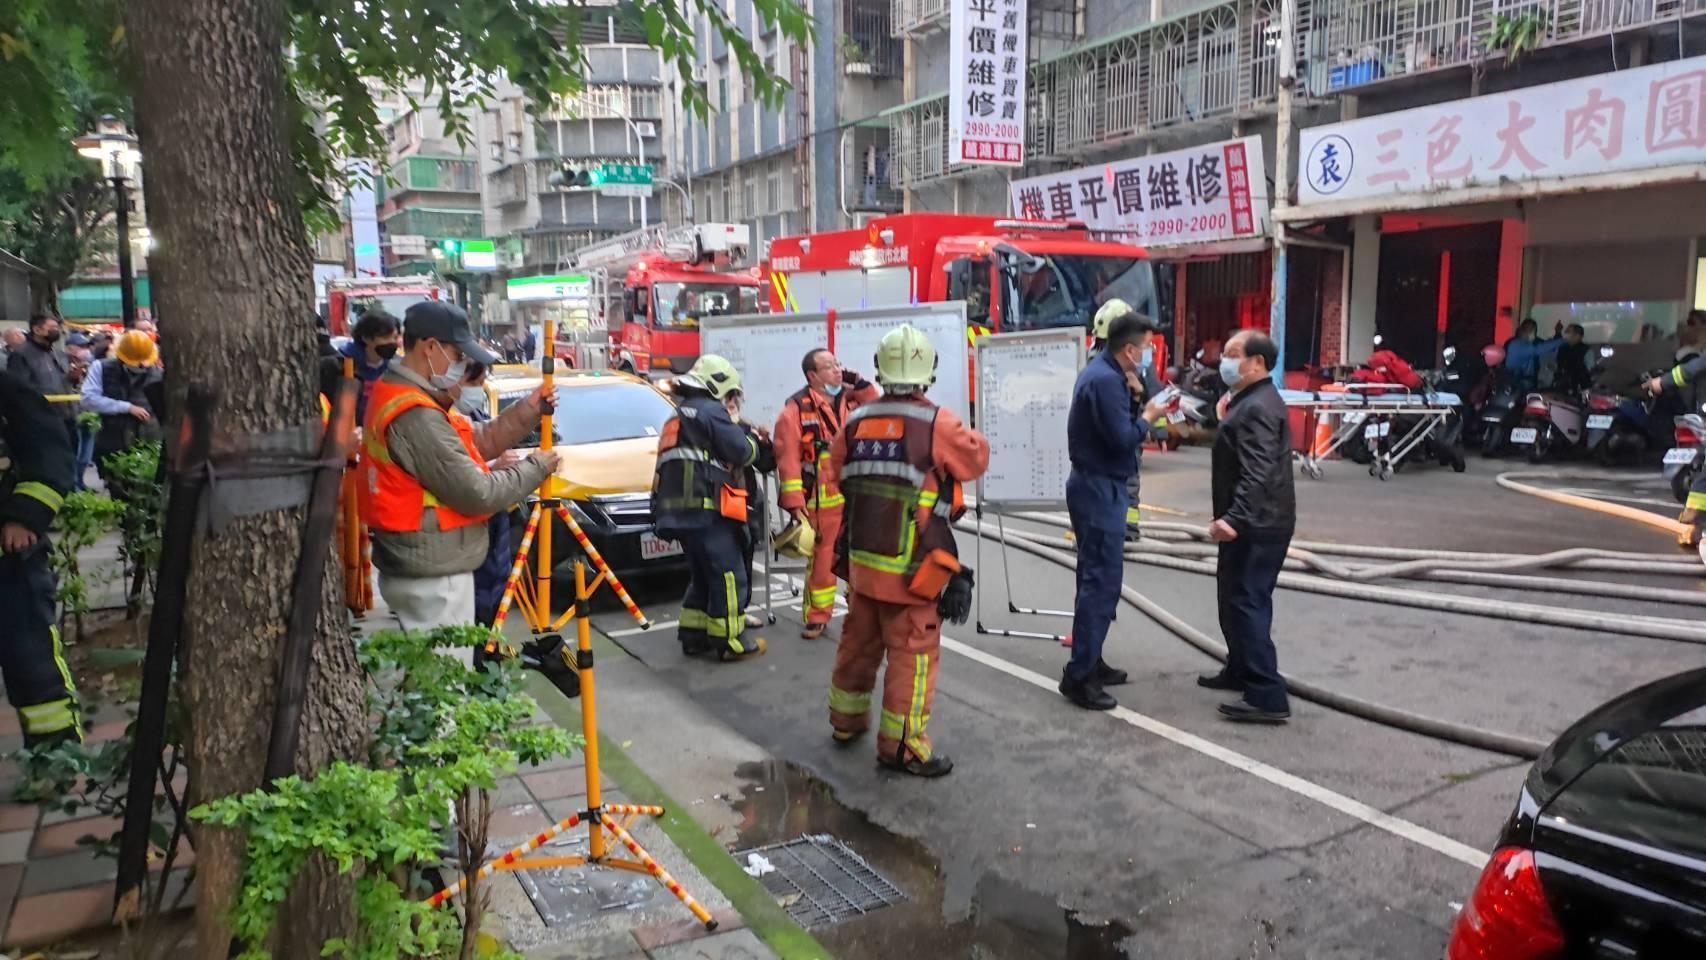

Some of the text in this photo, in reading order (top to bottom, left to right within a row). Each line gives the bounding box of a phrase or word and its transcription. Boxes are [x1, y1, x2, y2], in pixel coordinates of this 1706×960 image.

[965, 121, 1019, 139] 2990-2000
[1366, 69, 1706, 187] 三色大肉圓
[1018, 154, 1222, 220] 機車平價維修
